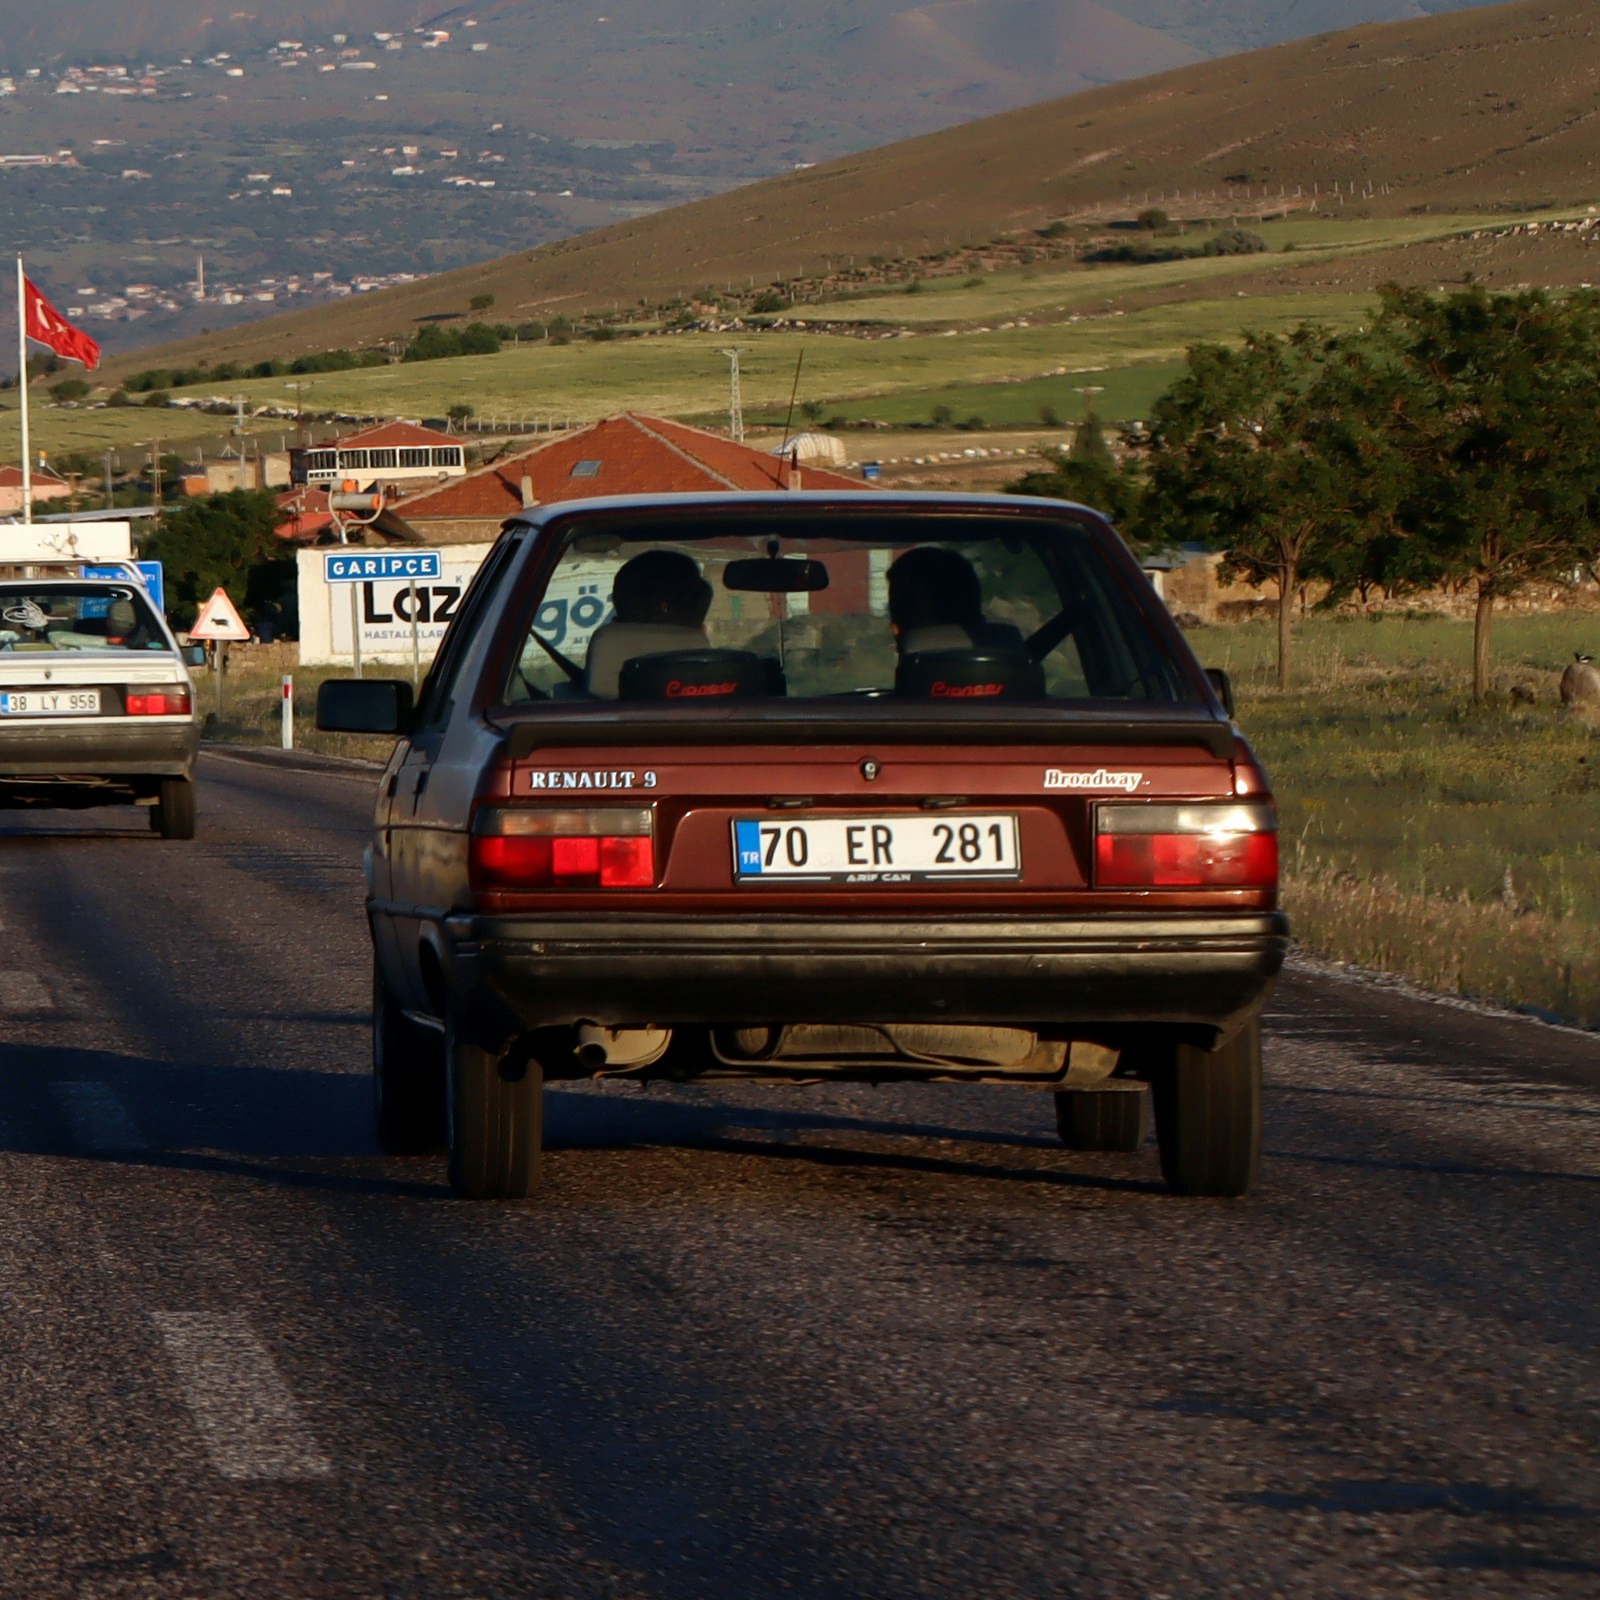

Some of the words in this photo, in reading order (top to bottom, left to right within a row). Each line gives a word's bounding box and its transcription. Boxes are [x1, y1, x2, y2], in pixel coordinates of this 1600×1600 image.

[332, 557, 432, 575] GARİPÇE
[10, 695, 27, 711] 38
[41, 695, 59, 711] LY
[70, 694, 97, 710] 958
[531, 771, 636, 789] RENAULT
[643, 771, 657, 788] 9
[1044, 769, 1143, 792] Broadway
[741, 851, 760, 863] TR
[760, 826, 809, 867] 70
[846, 825, 894, 865] ER
[933, 823, 1004, 863] 281
[881, 873, 912, 882] CAN
